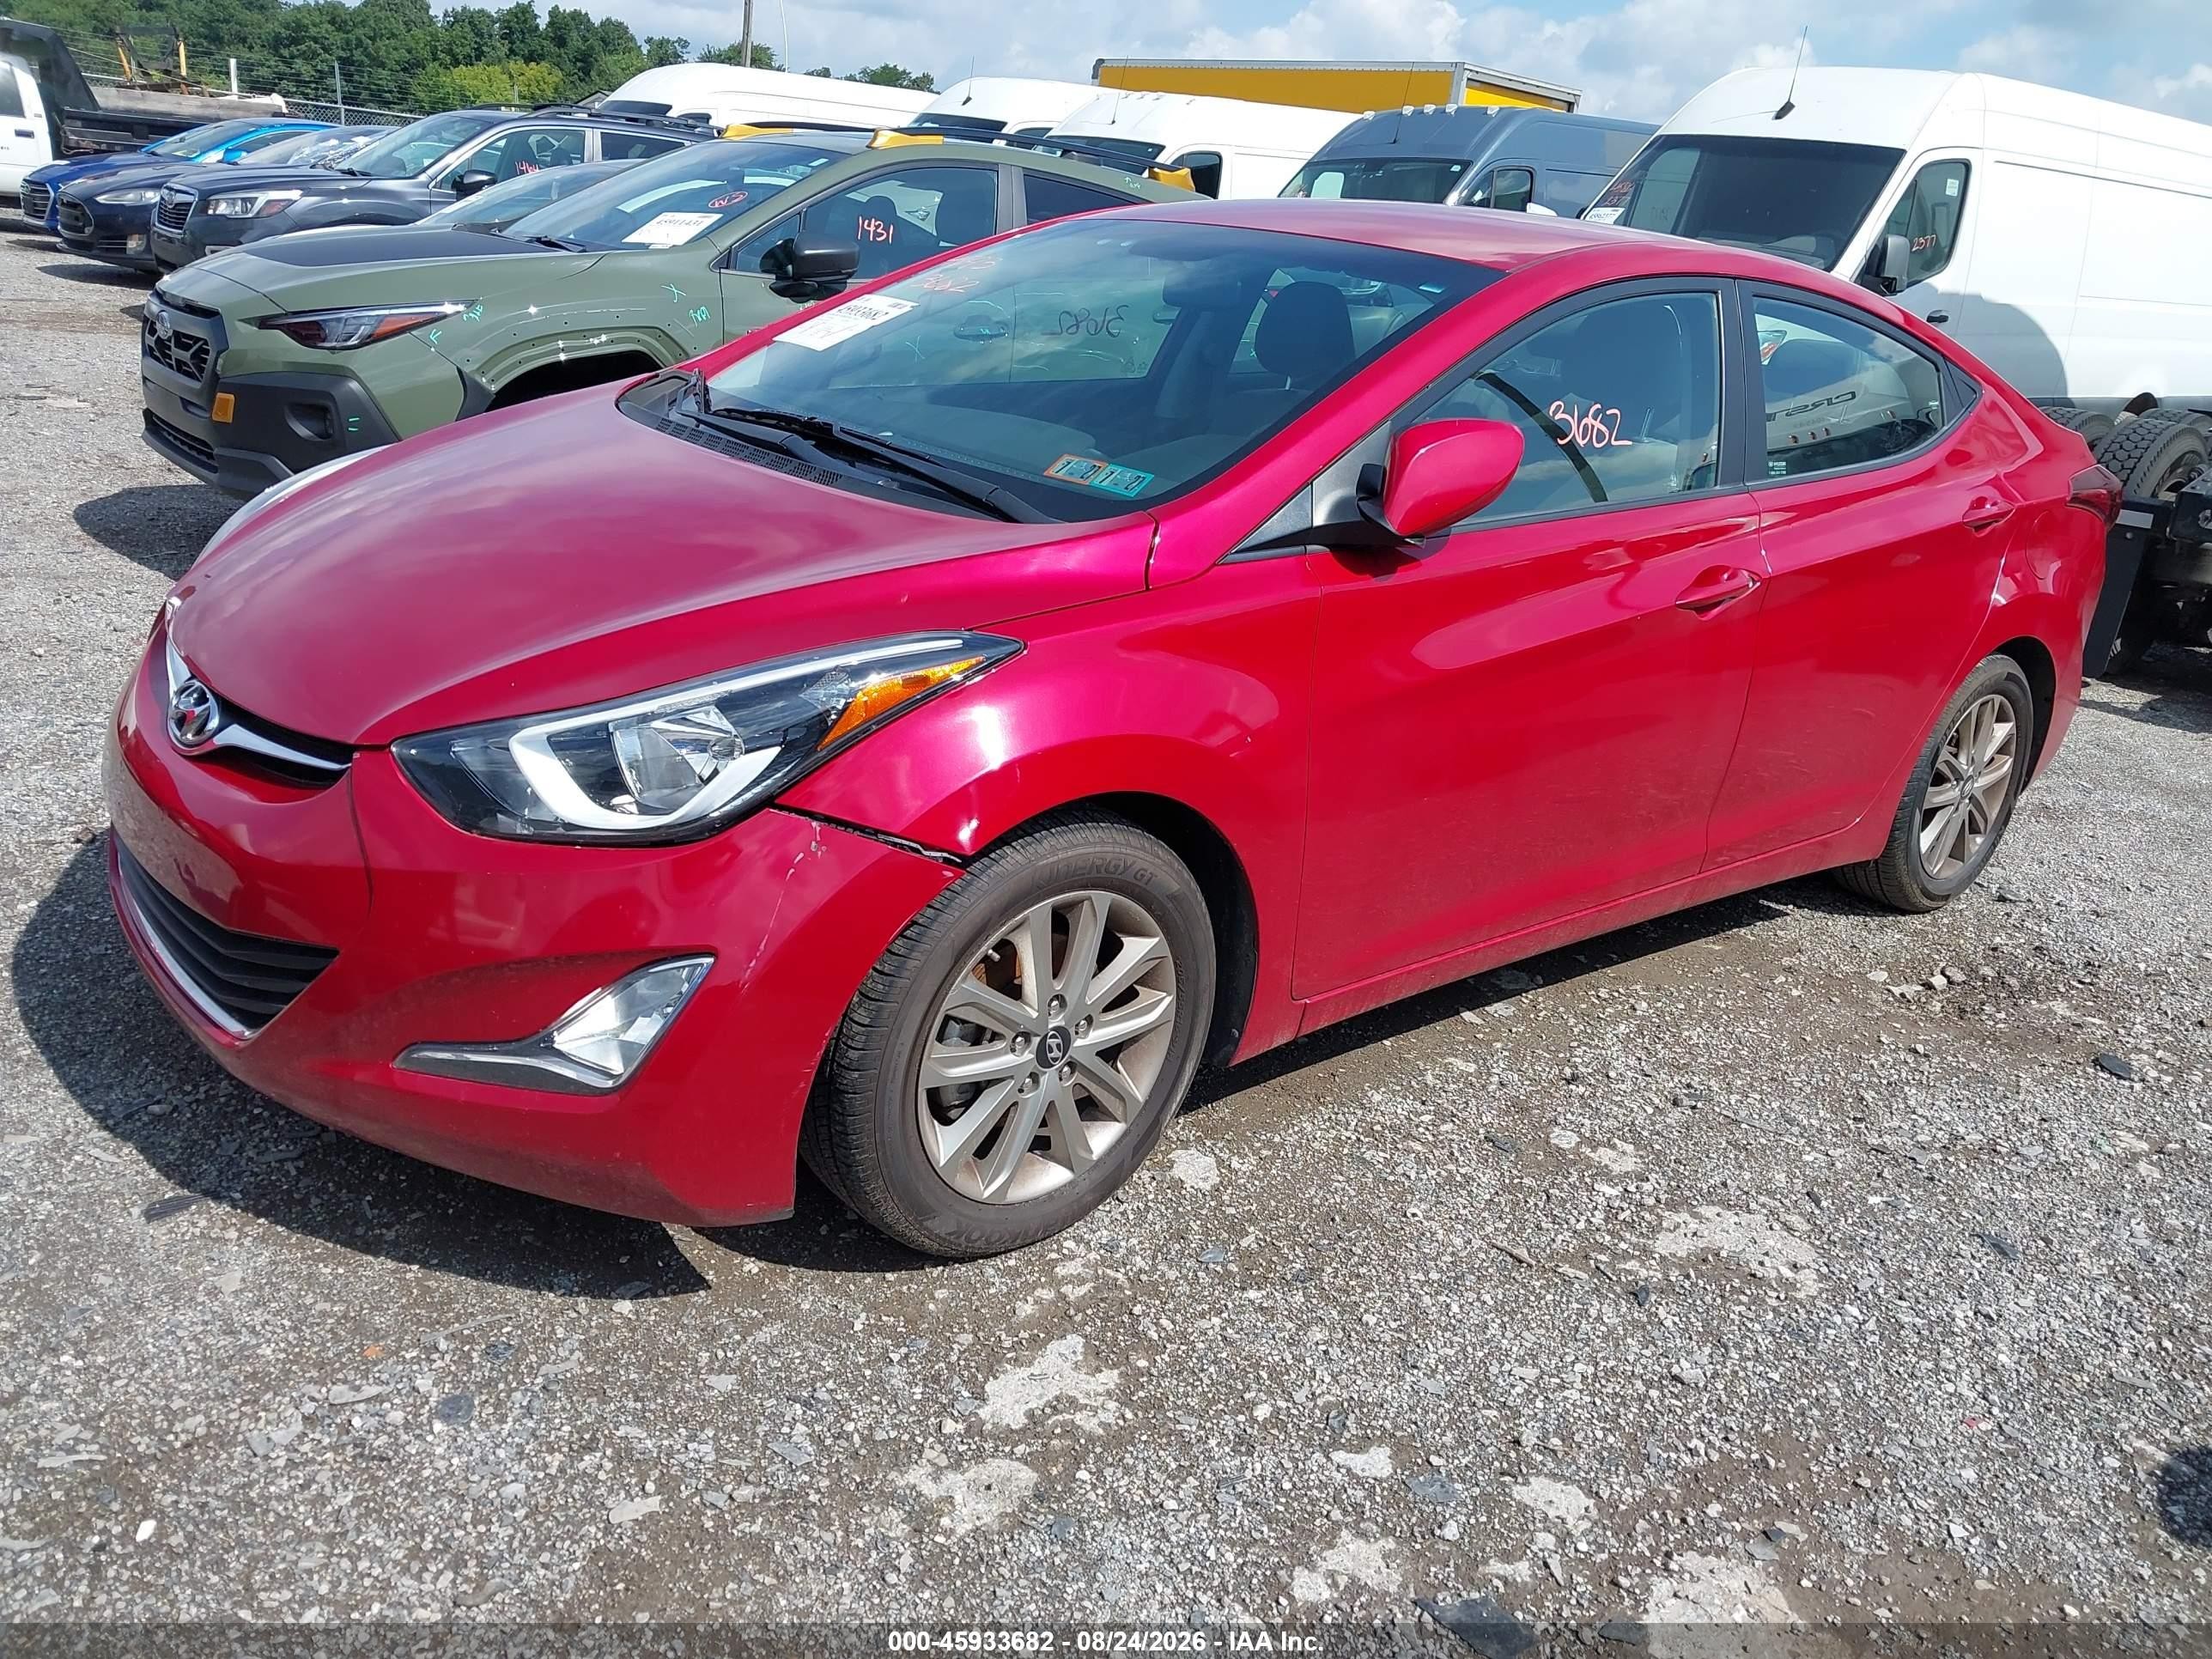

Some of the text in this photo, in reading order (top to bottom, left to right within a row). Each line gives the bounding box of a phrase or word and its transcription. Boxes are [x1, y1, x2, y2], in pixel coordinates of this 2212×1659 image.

[857, 216, 894, 245] 1431
[1911, 234, 1936, 252] 2377
[1549, 400, 1632, 448] 3682
